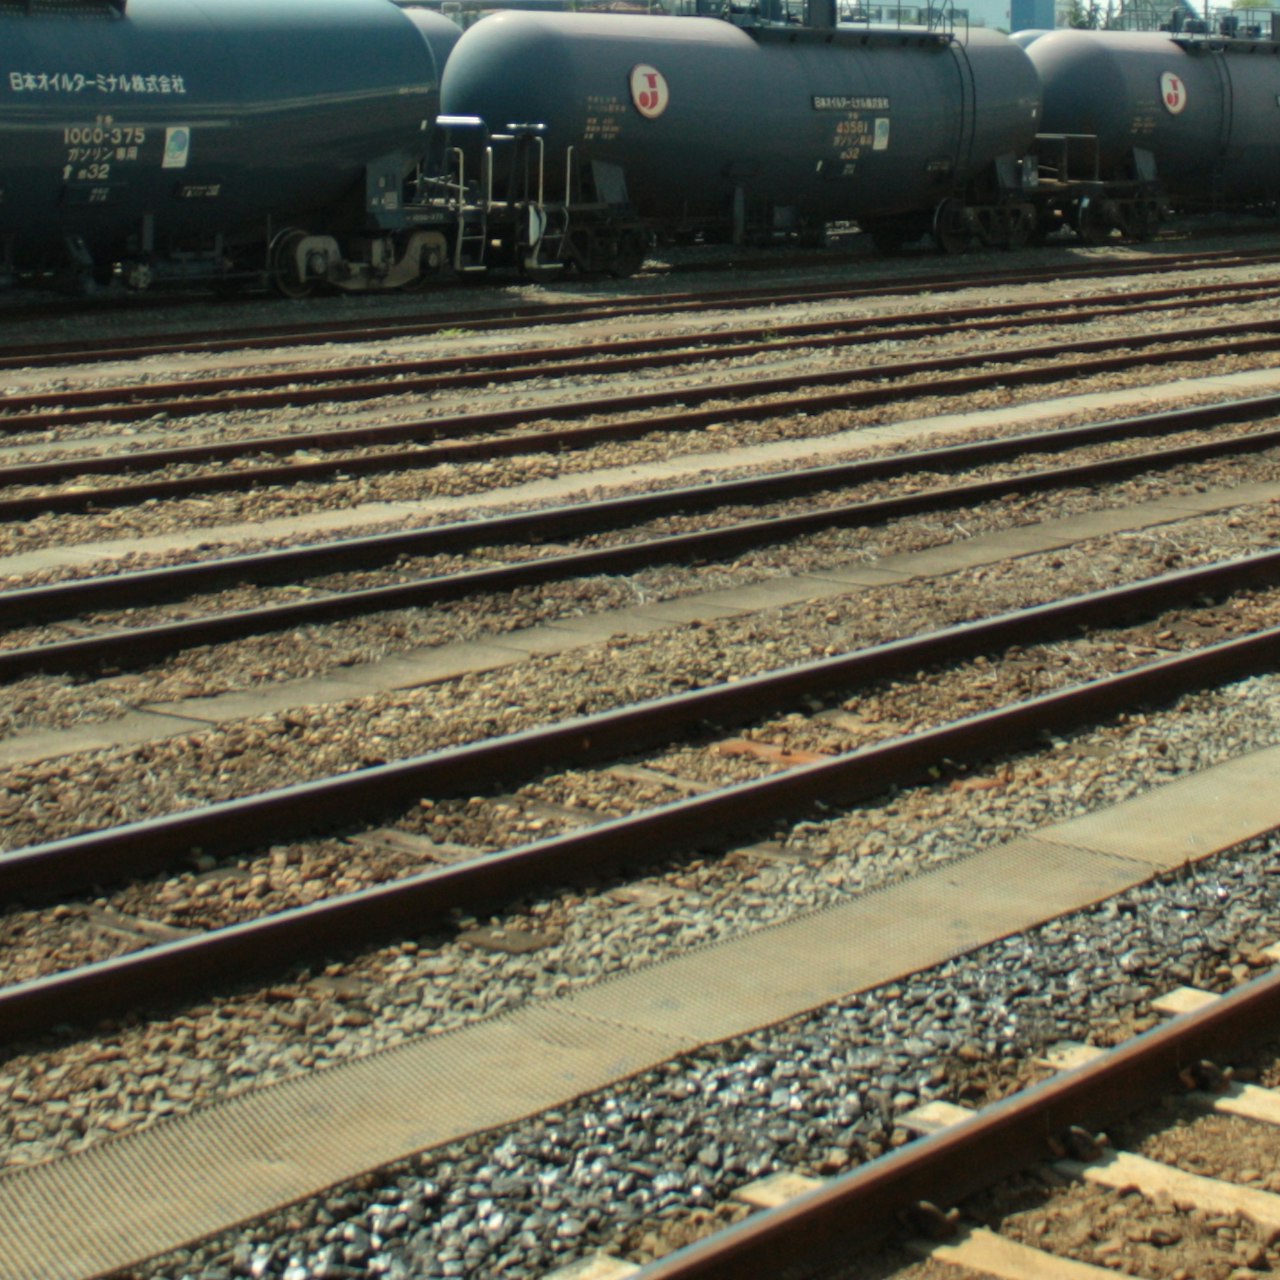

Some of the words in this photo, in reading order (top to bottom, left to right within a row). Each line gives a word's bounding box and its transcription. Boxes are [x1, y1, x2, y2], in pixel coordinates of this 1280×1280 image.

[10, 72, 186, 94] 日本オイルターミナル株式会社
[64, 127, 146, 144] 1000-375
